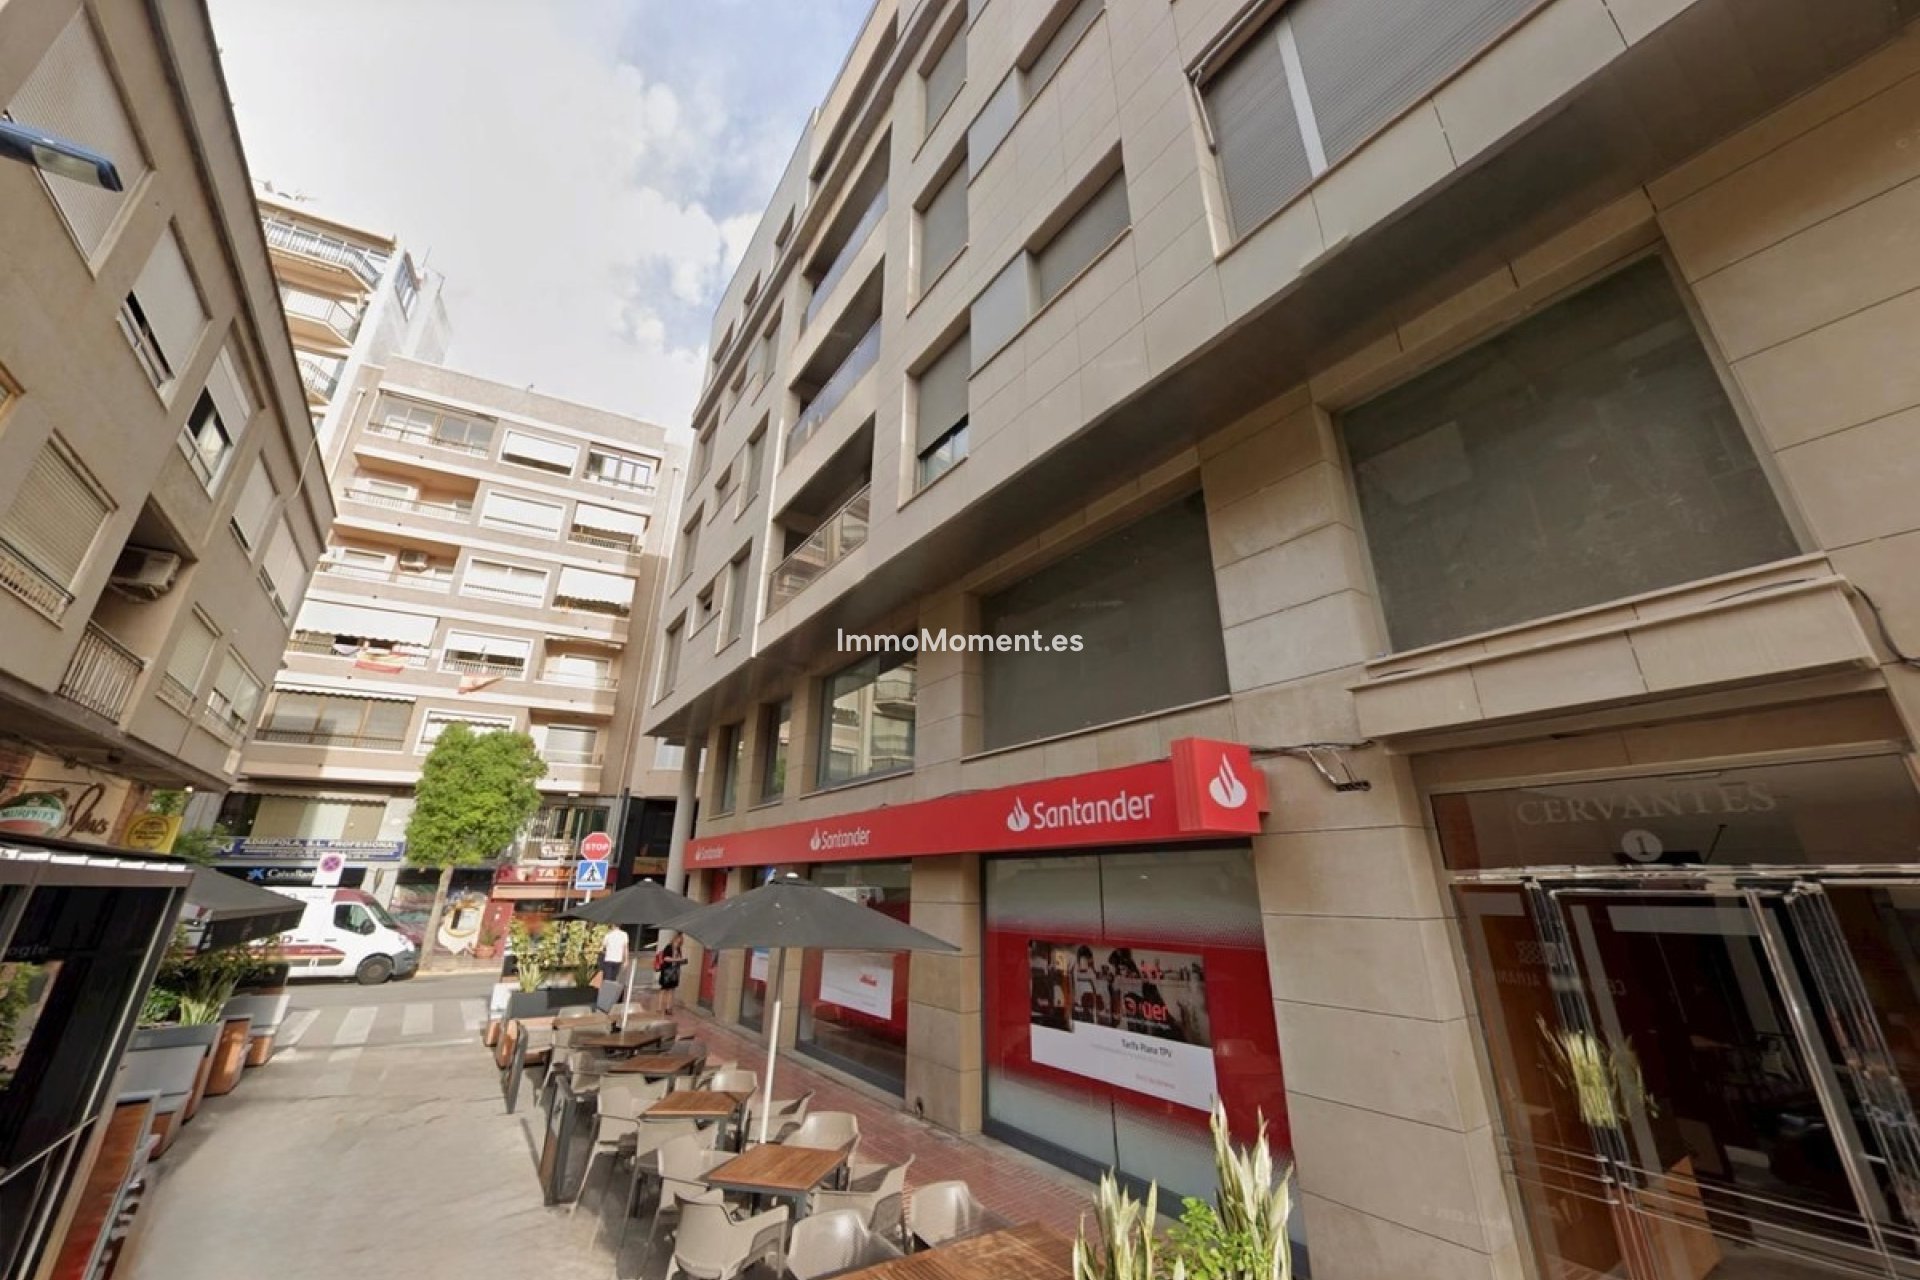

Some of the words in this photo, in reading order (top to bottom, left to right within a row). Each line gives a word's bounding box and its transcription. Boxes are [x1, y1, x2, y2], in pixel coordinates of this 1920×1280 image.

[1033, 790, 1155, 831] Santander
[1516, 782, 1777, 826] CERVANTES
[585, 843, 609, 851] STOP
[820, 827, 872, 850] Santander
[1634, 836, 1652, 857] 1
